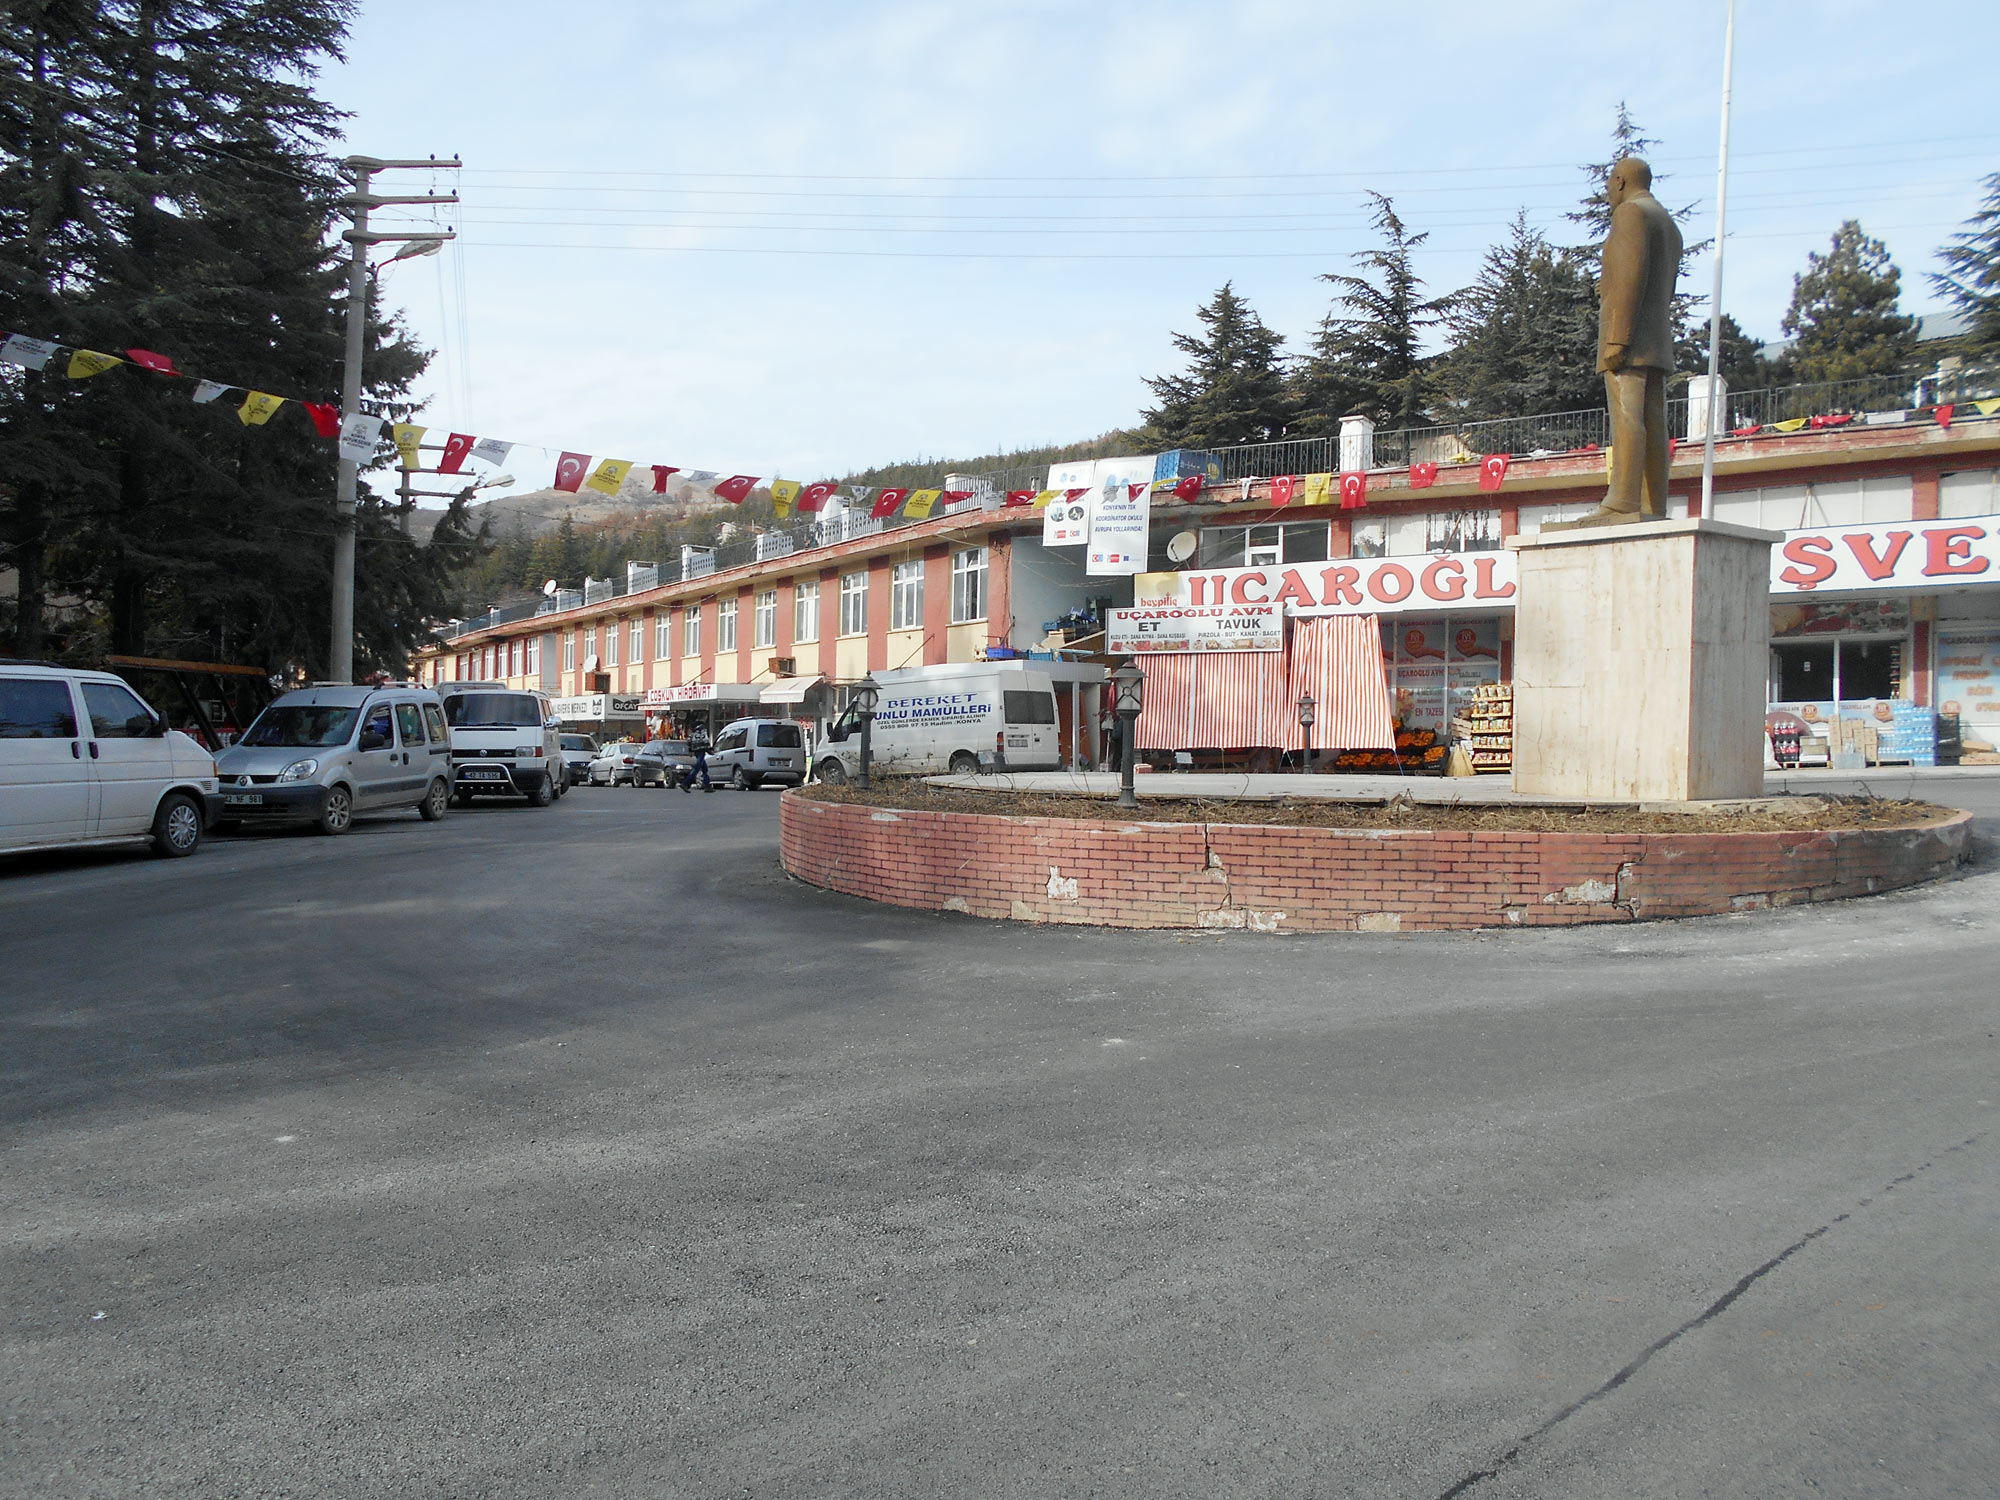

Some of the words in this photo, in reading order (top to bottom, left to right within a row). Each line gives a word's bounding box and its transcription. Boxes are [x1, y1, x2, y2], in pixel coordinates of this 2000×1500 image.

[1779, 525, 1993, 591] ŞVE
[1229, 606, 1273, 617] AVM
[1138, 621, 1161, 632] ET
[1216, 618, 1261, 630] TAVUK
[888, 693, 977, 708] BEREKET
[874, 710, 908, 721] UNLU
